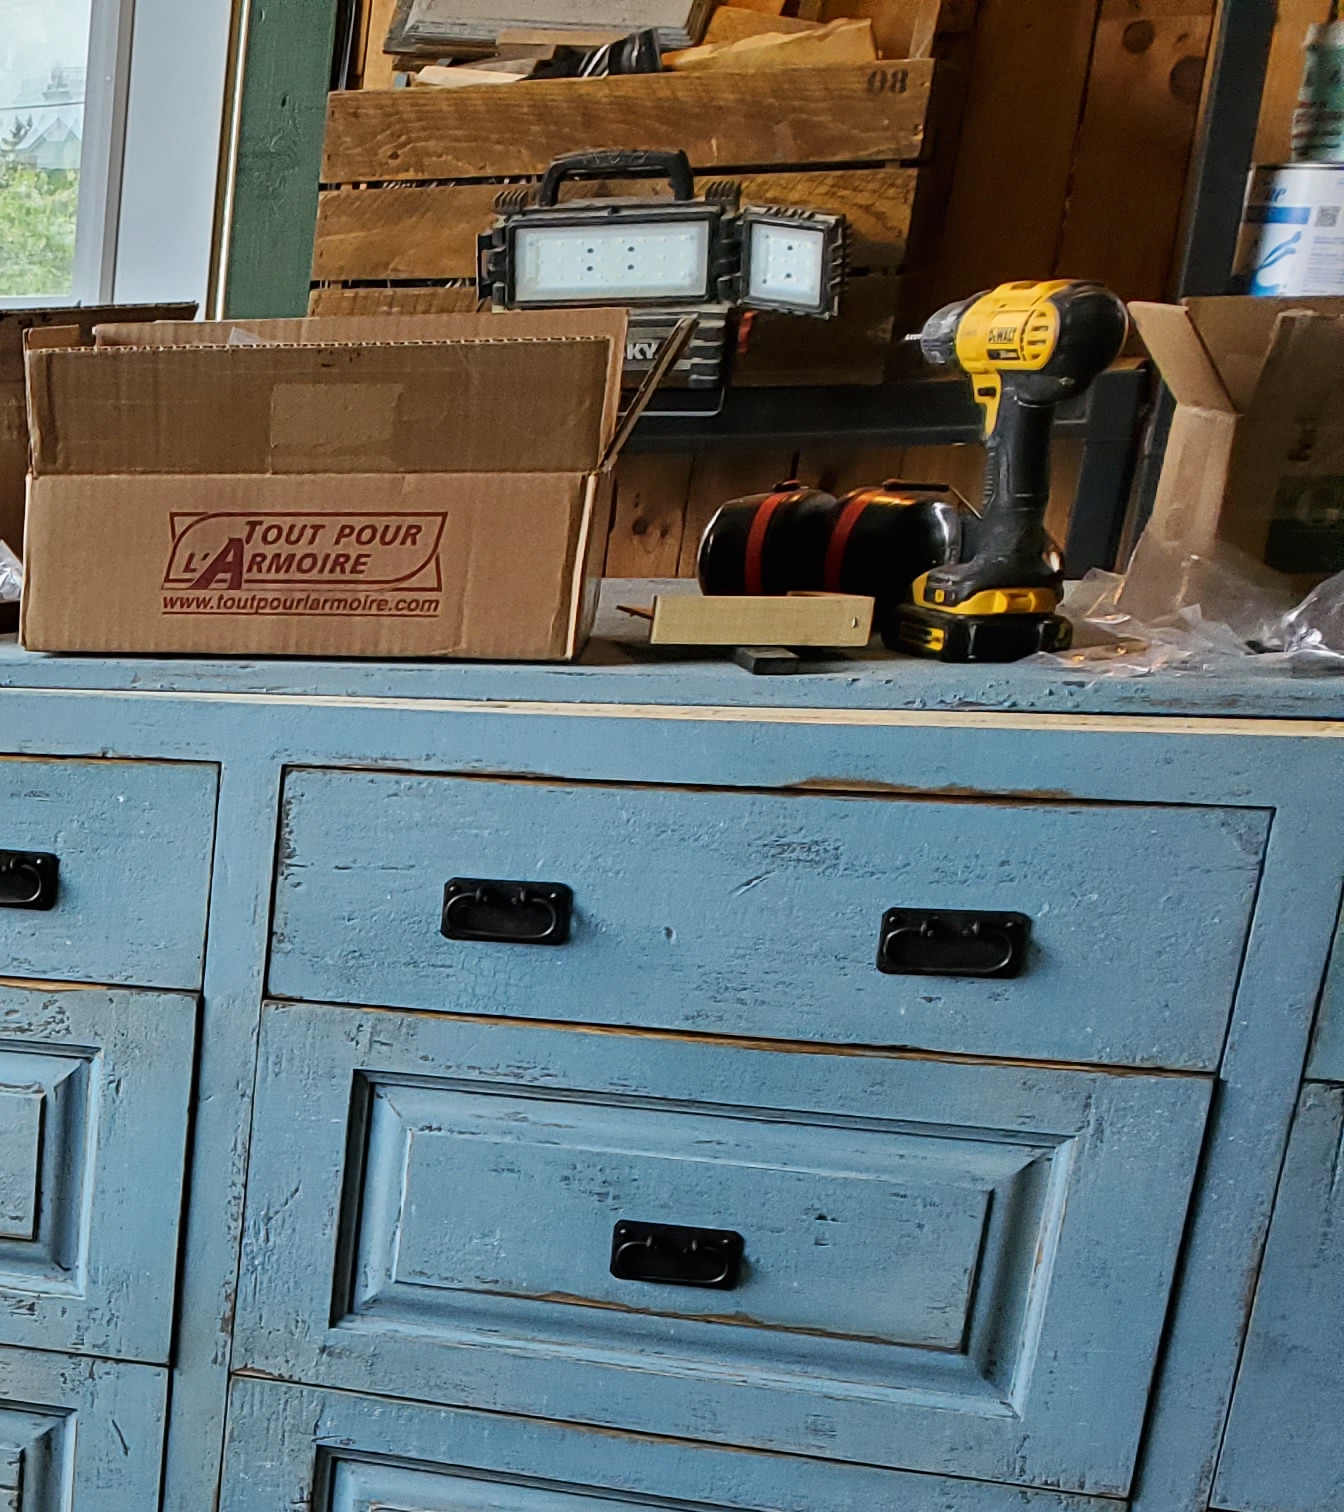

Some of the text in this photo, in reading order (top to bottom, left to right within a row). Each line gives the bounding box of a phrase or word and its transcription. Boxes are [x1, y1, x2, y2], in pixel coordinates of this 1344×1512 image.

[244, 520, 423, 546] TOUT POUR
[182, 537, 372, 590] L'ARMOIRE
[162, 593, 440, 613] www.toutpourlarmoire.com
